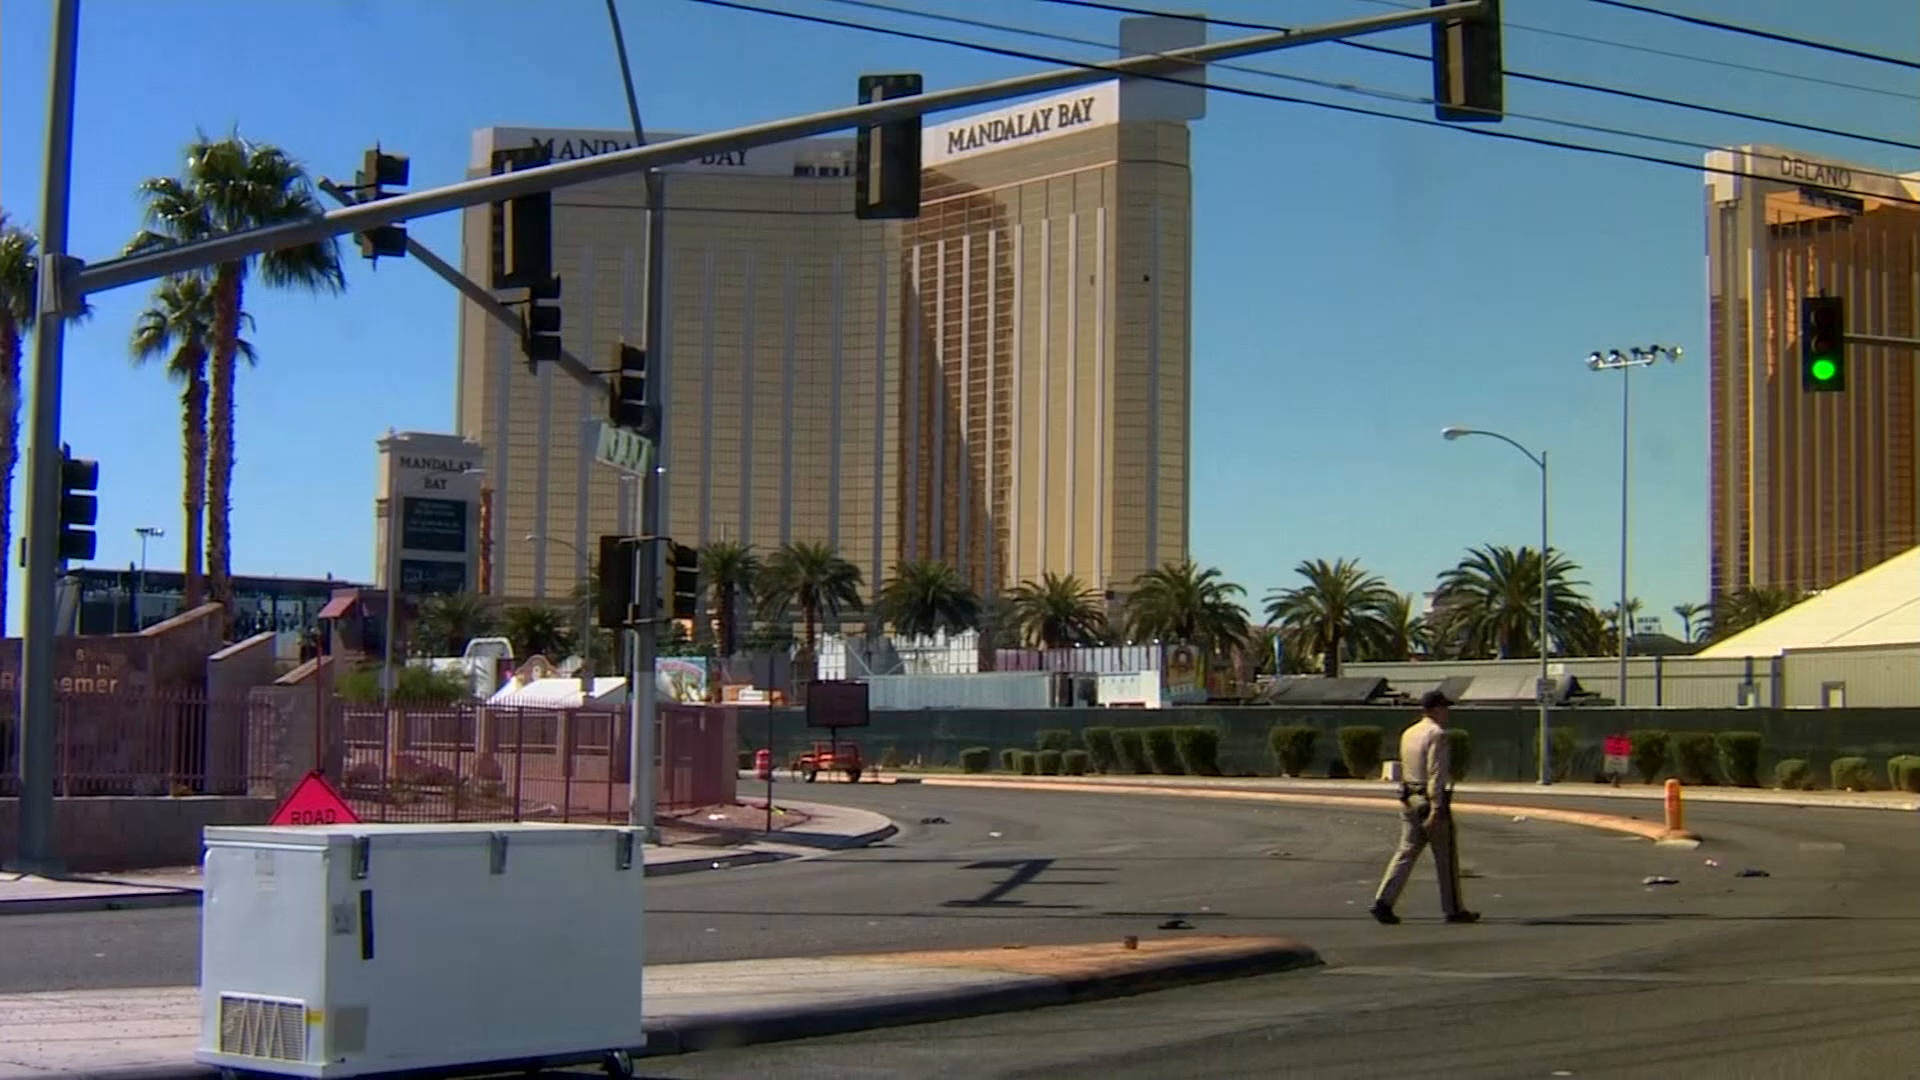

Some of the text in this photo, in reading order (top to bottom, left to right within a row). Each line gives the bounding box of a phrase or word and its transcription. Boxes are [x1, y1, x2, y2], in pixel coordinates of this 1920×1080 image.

[948, 97, 1095, 154] MANDALAY BAY
[1780, 155, 1852, 187] DELANO
[400, 456, 473, 472] MANDALAY
[424, 477, 448, 490] BAY
[1, 672, 118, 694] Remer
[291, 809, 336, 825] ROAD
